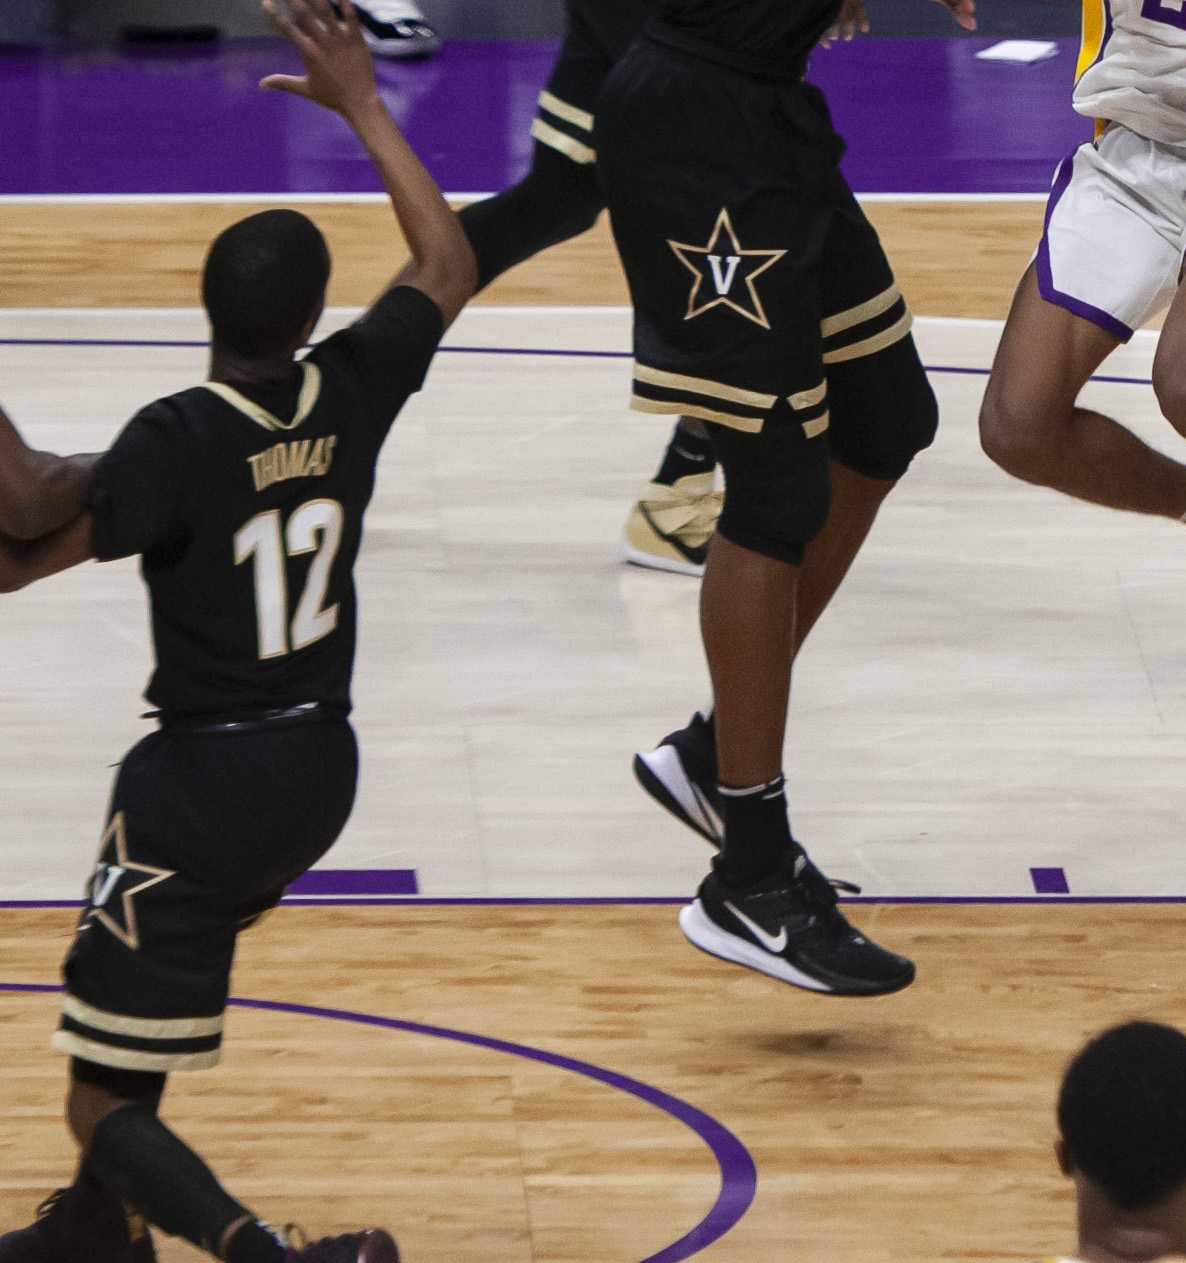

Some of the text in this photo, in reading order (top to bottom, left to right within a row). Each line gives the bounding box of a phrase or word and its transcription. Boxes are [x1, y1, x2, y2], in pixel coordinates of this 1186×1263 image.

[707, 254, 742, 295] V
[246, 434, 338, 492] THOMAS
[233, 497, 345, 661] 12
